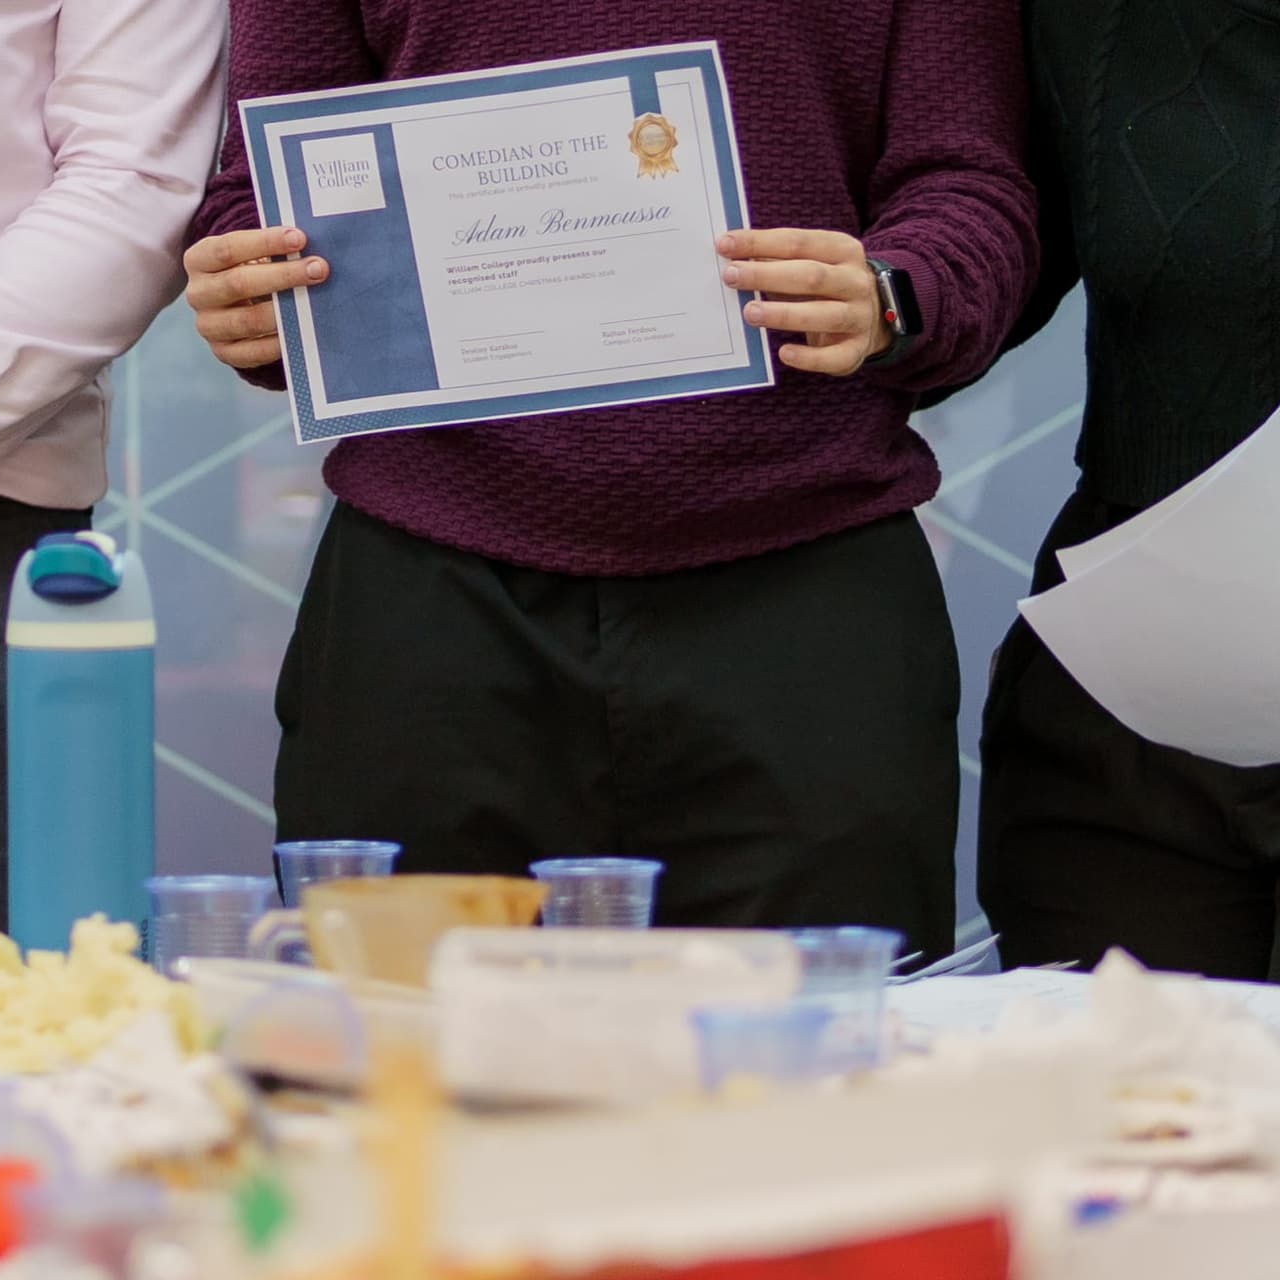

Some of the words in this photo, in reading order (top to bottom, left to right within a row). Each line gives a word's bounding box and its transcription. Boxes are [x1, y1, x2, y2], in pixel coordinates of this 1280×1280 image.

[432, 146, 534, 172] COMEDIAN
[539, 140, 564, 157] OF
[569, 134, 609, 154] THE
[312, 159, 370, 176] William
[478, 160, 569, 186] BUILDING
[318, 173, 369, 189] College
[452, 214, 528, 246] Adam
[536, 205, 671, 235] Benmoussa
[447, 263, 480, 274] William
[481, 260, 514, 271] College
[517, 255, 551, 268] proudly
[552, 251, 590, 263] presents
[448, 274, 496, 287] recognised
[498, 270, 518, 280] staff
